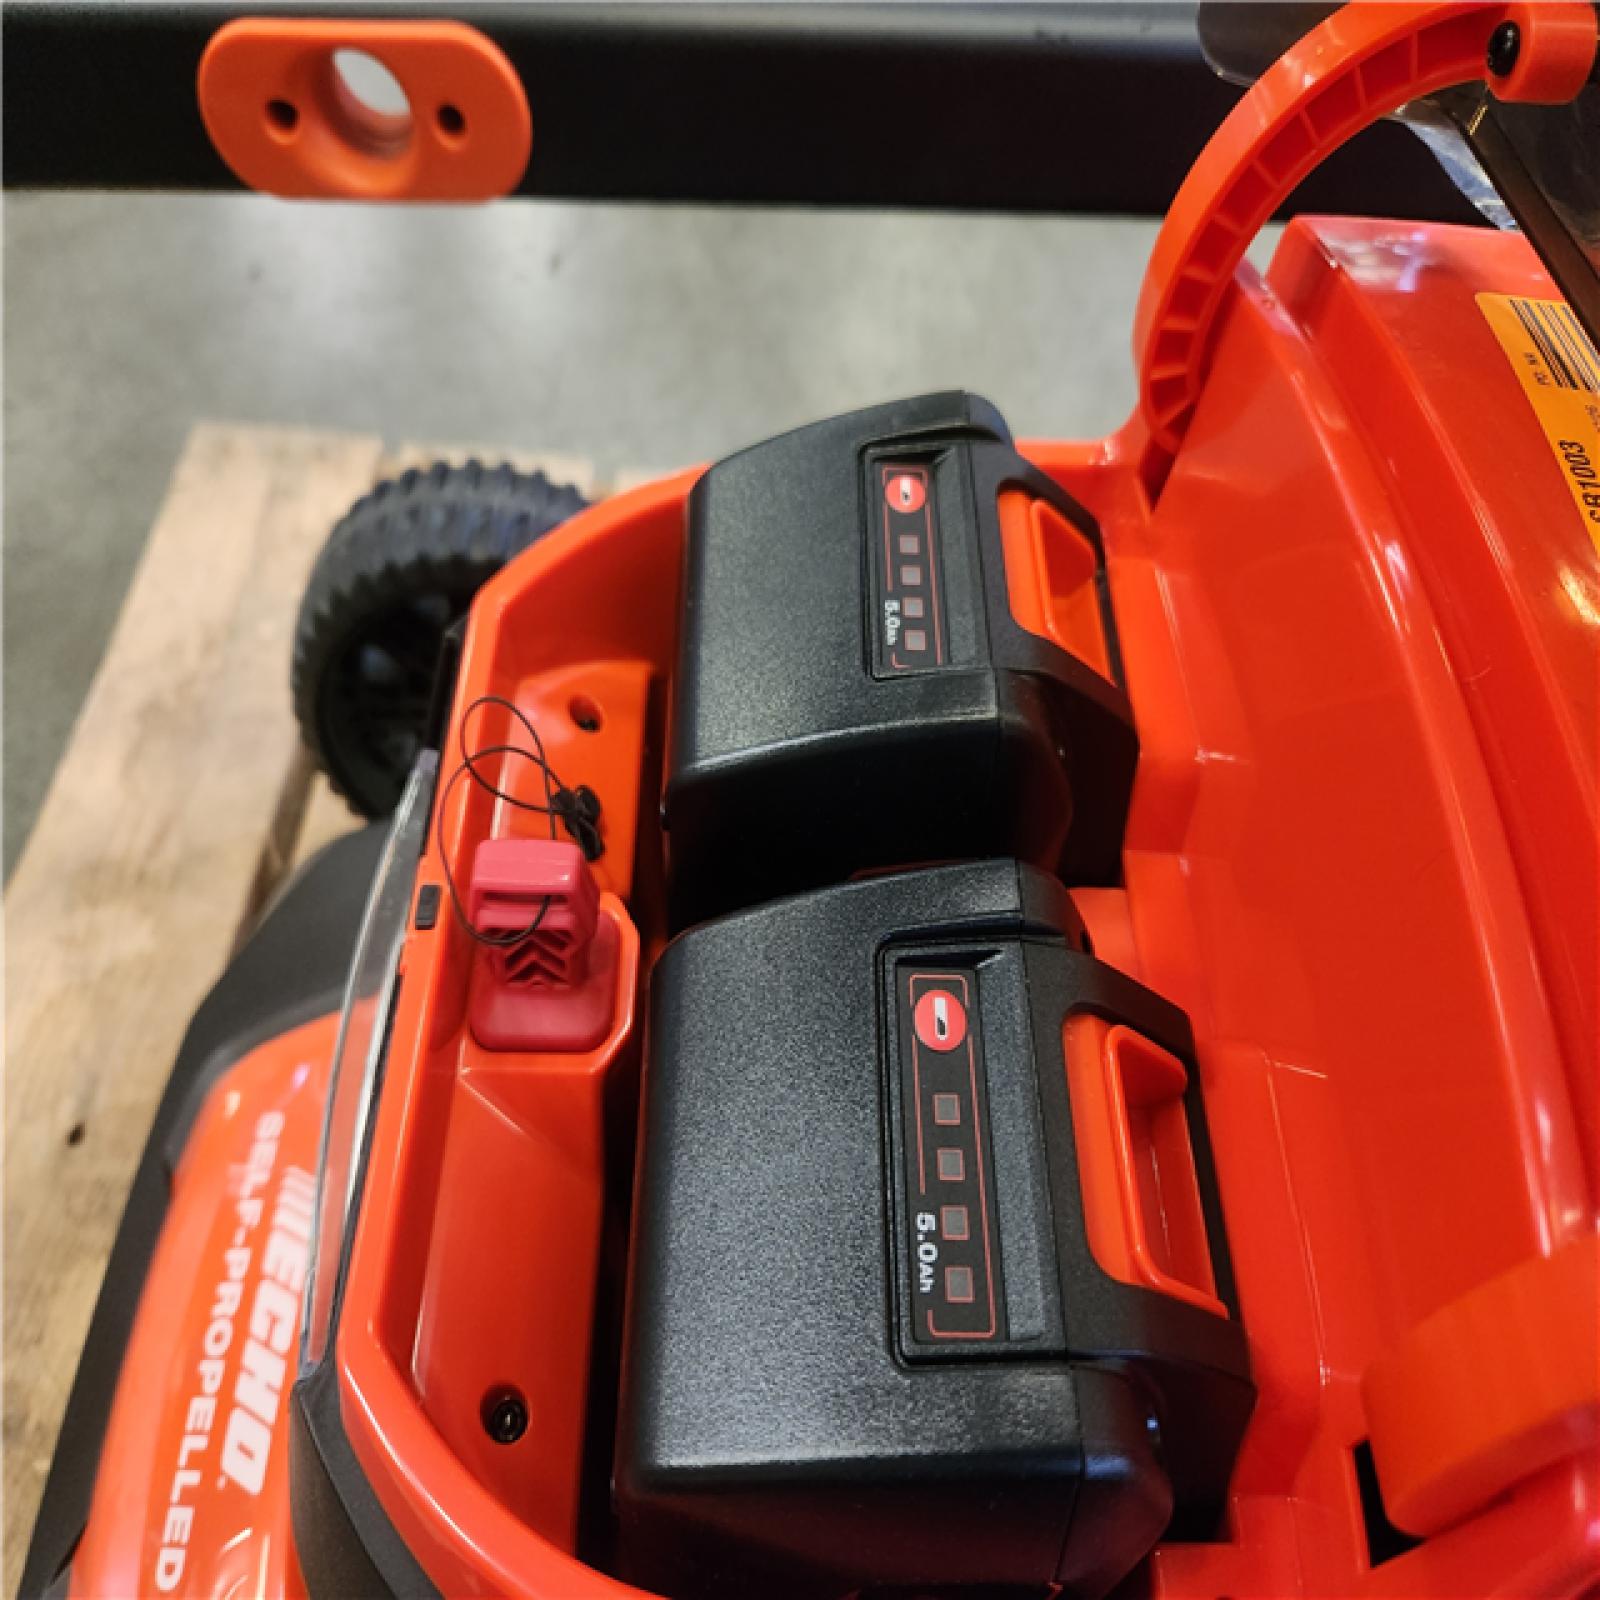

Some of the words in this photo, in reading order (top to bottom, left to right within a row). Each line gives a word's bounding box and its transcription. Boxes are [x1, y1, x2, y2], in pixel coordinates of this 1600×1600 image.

[154, 1110, 286, 1592] SELF-PROPELLED
[221, 1232, 308, 1497] ECHO
[916, 1212, 938, 1294] 5.0Ah
